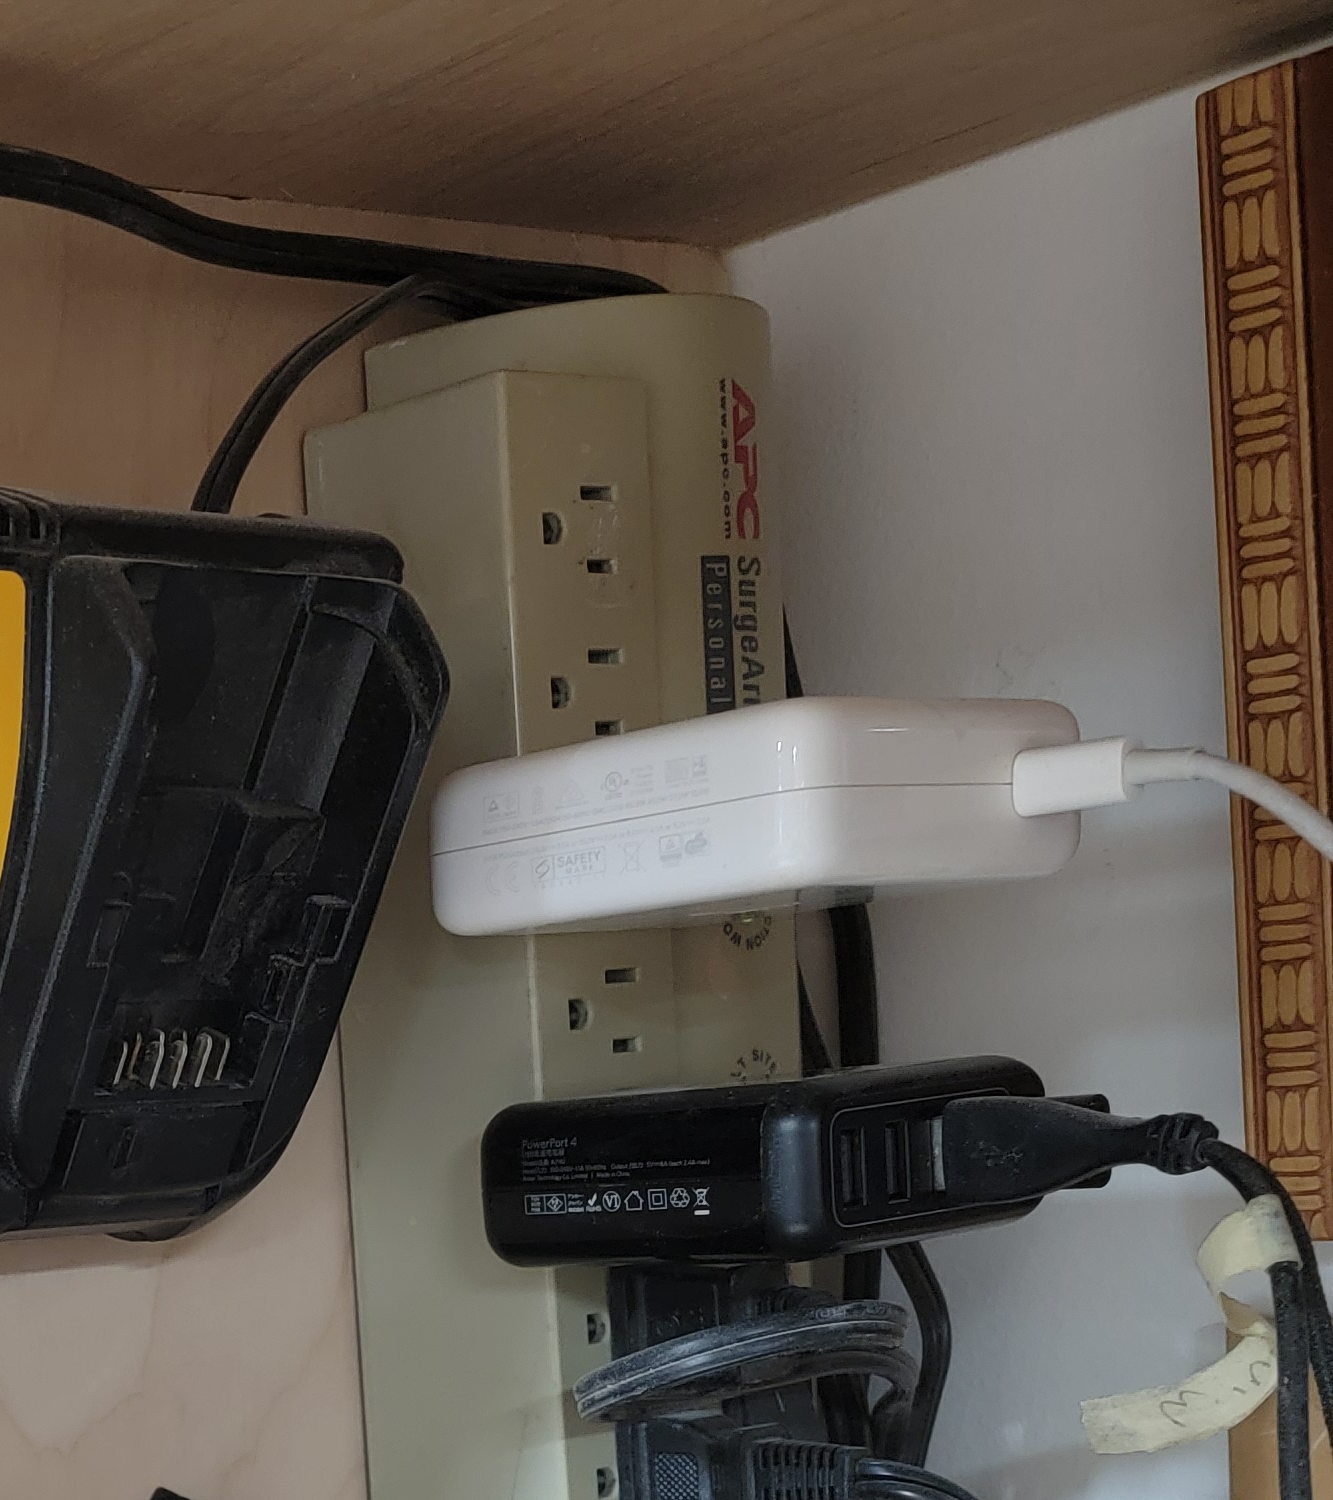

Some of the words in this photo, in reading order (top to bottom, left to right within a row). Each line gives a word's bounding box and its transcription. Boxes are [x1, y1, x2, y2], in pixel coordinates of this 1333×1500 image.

[720, 378, 731, 540] www.apc.com
[732, 379, 760, 540] APC
[705, 562, 731, 714] Personal
[555, 849, 601, 868] SAFETY
[521, 1137, 568, 1149] PowerPort
[570, 1137, 577, 1145] 4
